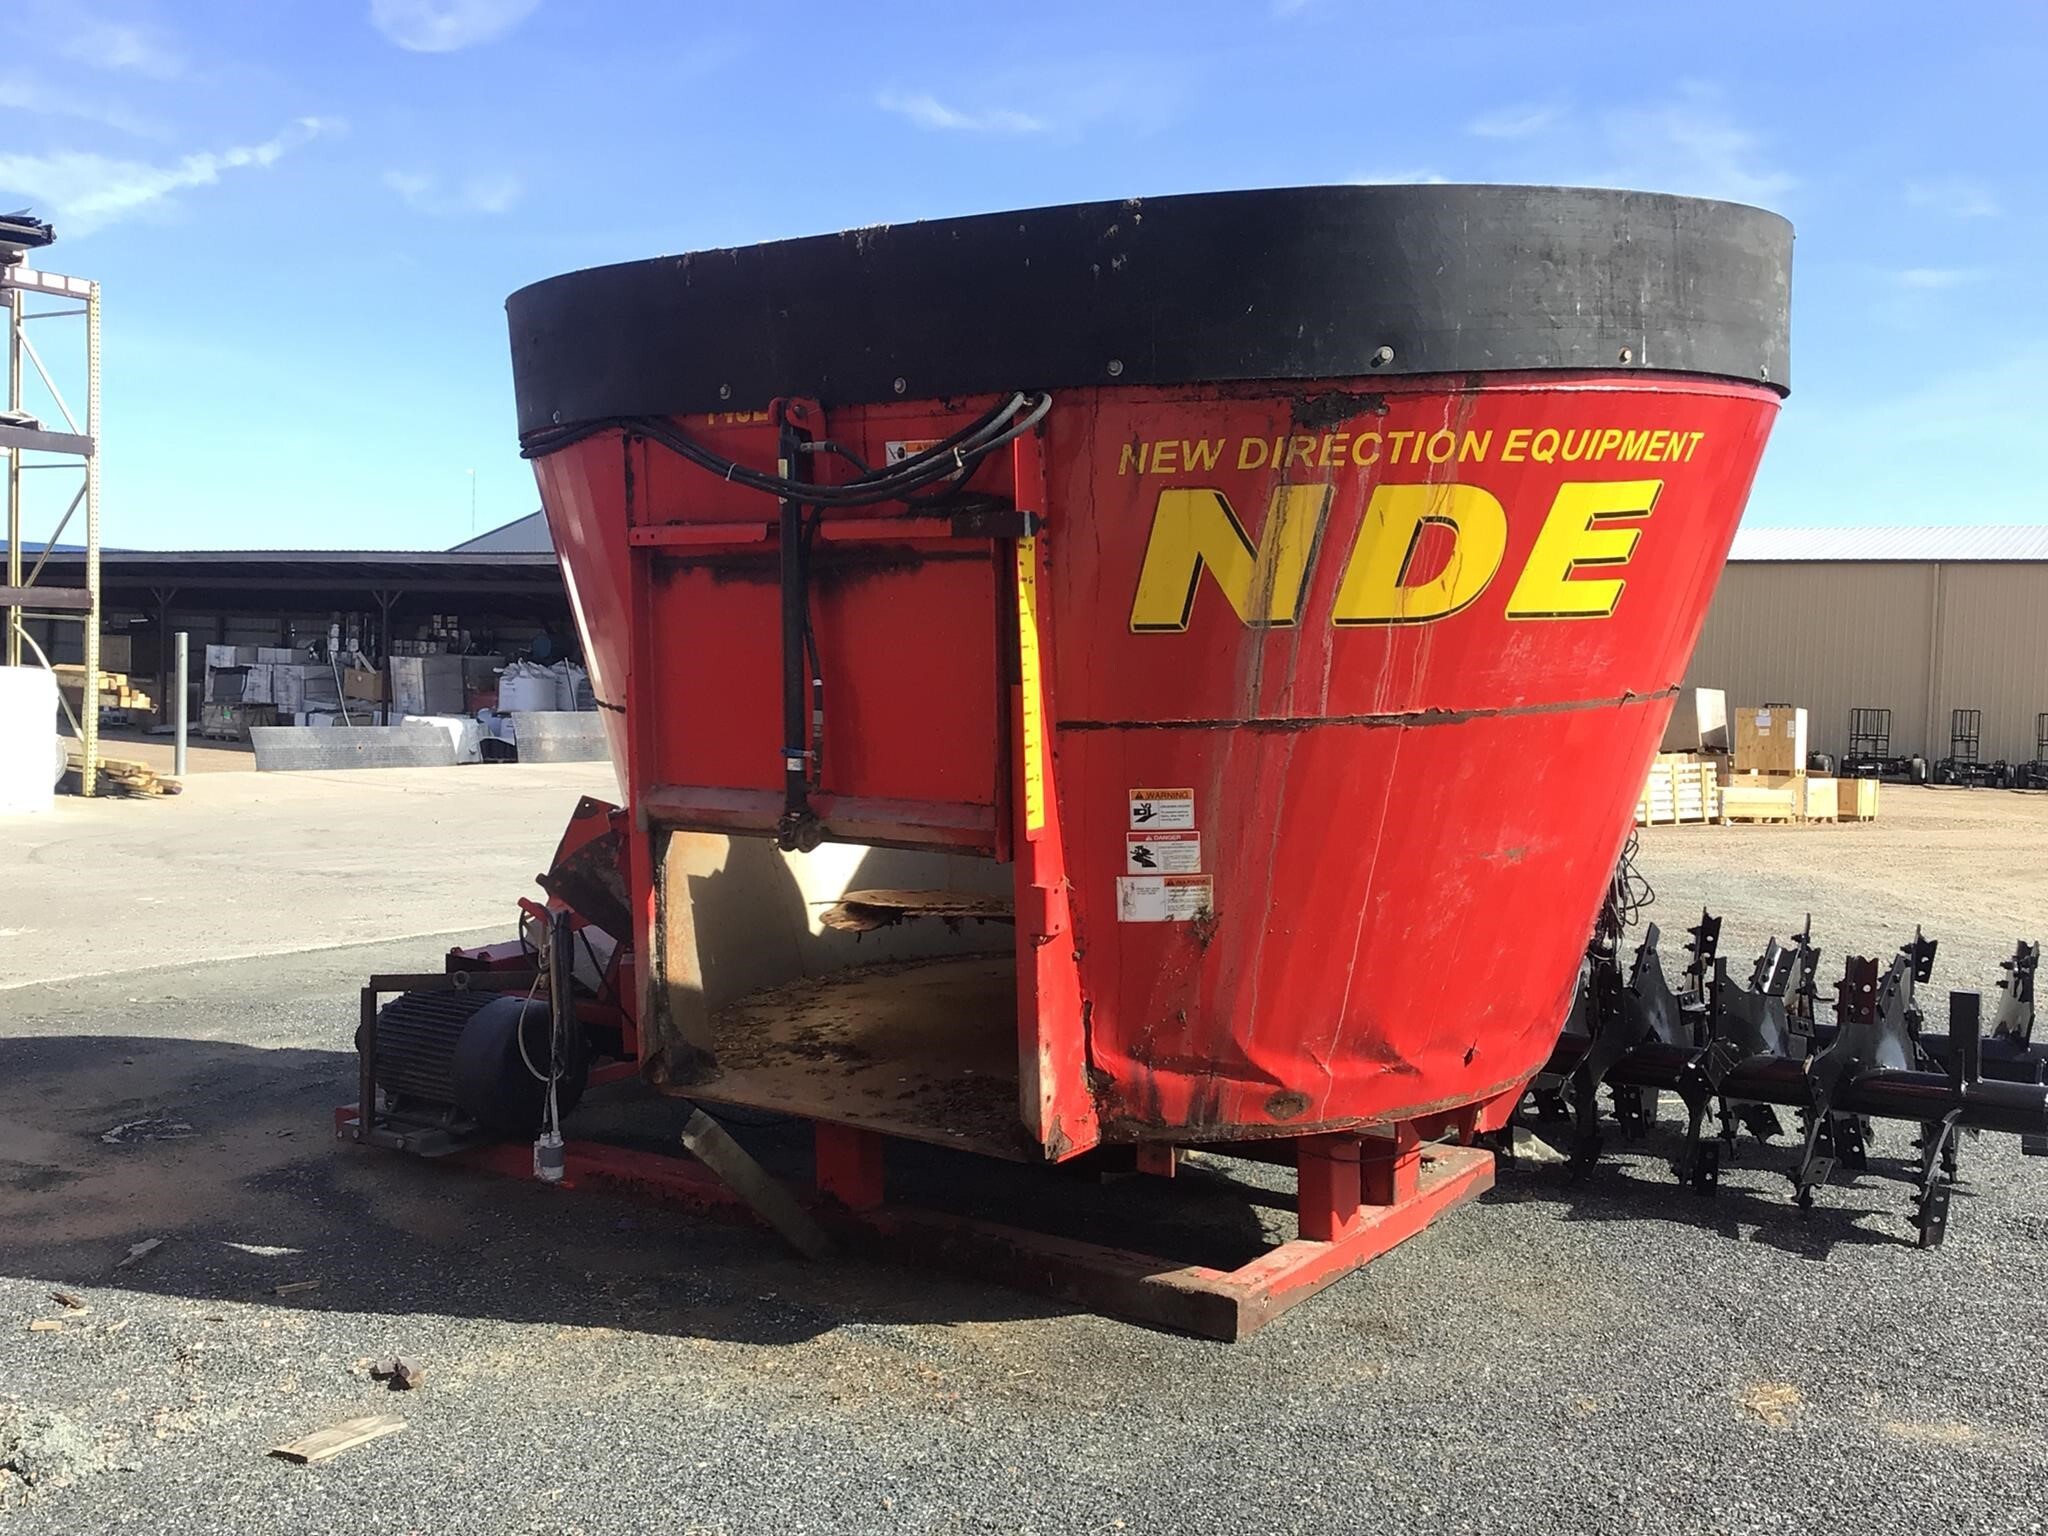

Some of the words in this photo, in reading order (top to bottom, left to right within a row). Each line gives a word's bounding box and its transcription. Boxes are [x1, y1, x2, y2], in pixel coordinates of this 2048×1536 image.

[1118, 437, 1224, 475] NEW
[1237, 429, 1492, 470] DIRECTION
[1501, 427, 1705, 464] EQUIPMENT
[1130, 479, 1664, 634] NDE
[1146, 790, 1189, 800] WARNING
